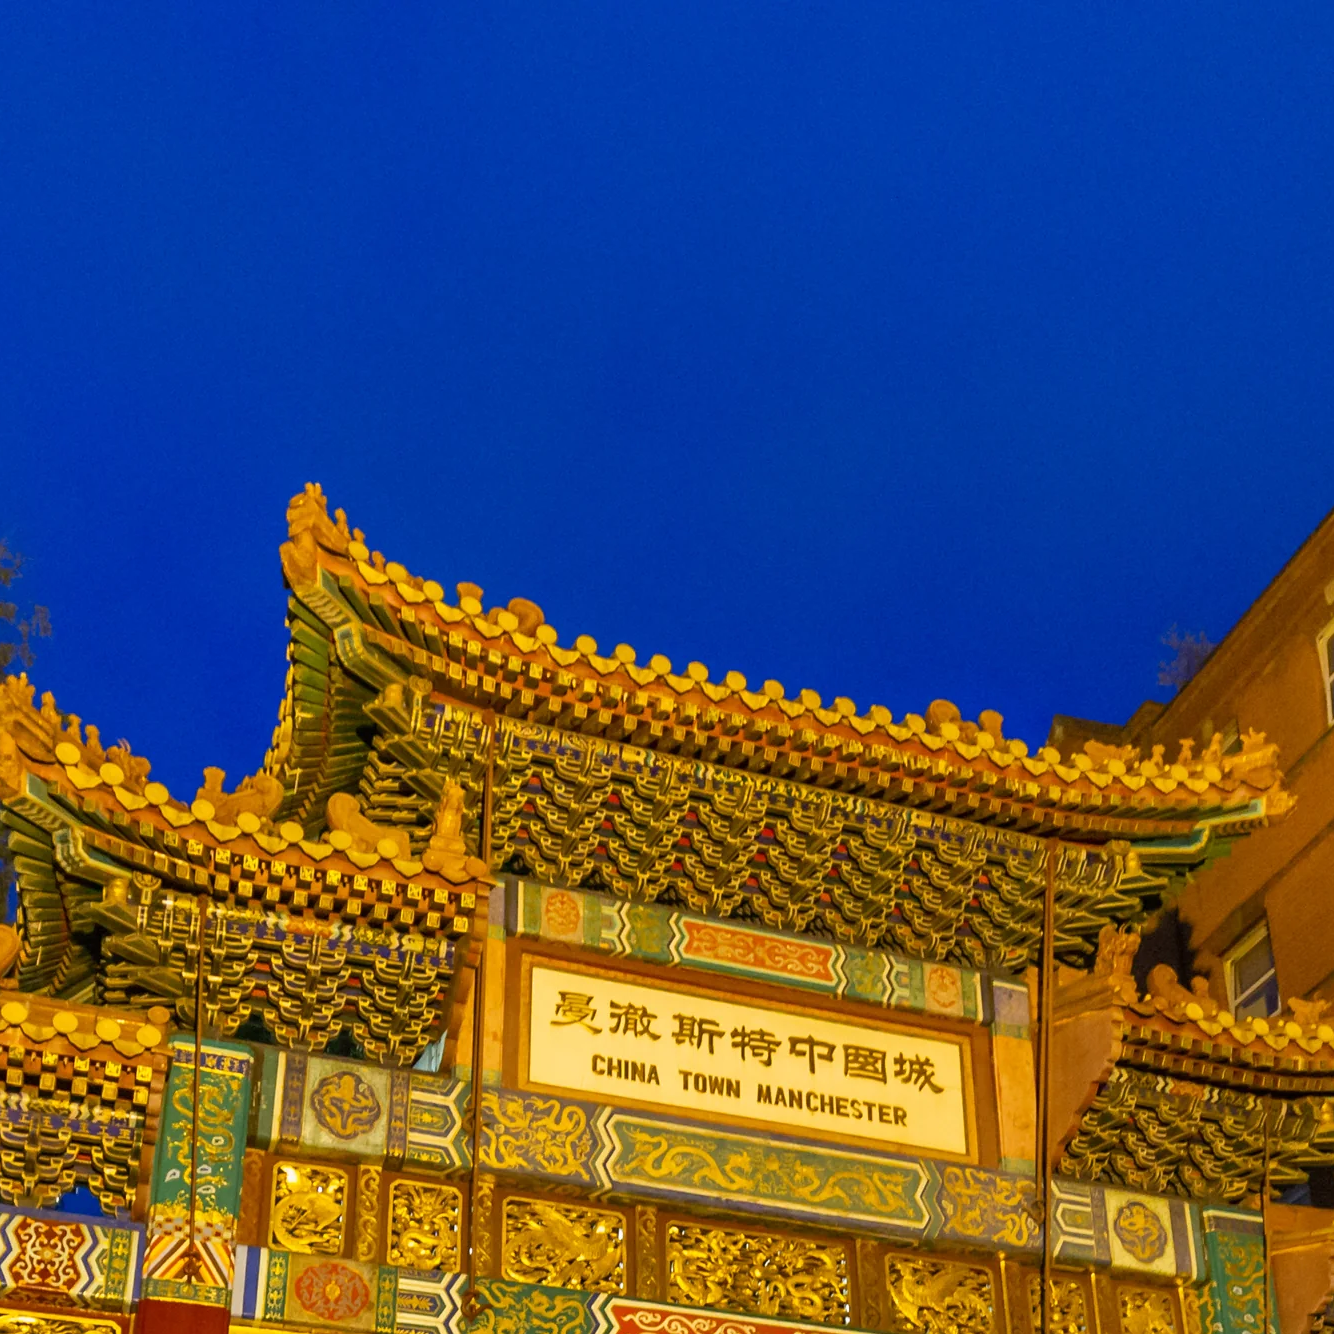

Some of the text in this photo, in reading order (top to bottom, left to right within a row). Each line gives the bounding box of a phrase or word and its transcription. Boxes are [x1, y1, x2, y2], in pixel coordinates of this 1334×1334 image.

[550, 991, 945, 1095] 曼徹斯特中國城
[591, 1054, 908, 1127] CHINA TOWN MANCHESTER
